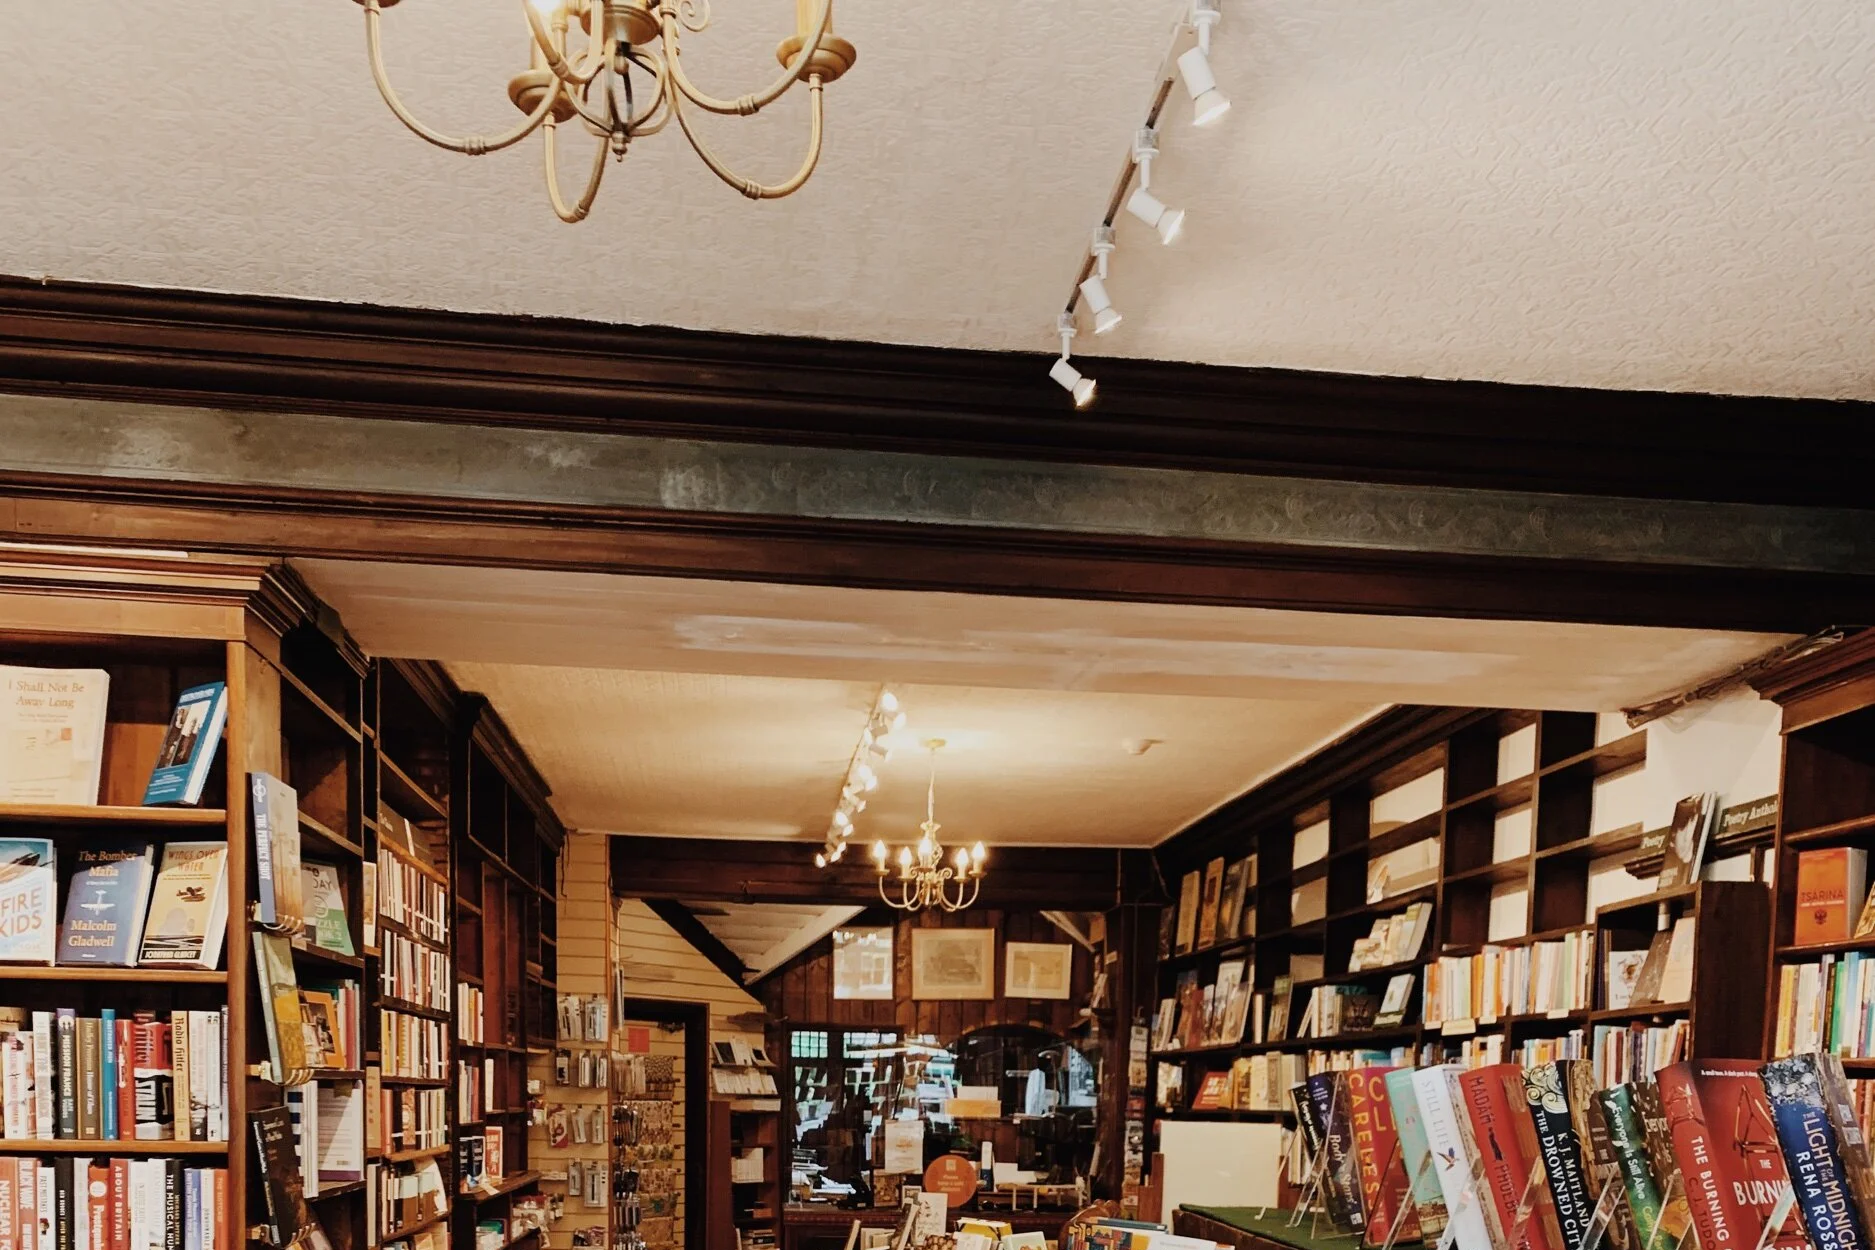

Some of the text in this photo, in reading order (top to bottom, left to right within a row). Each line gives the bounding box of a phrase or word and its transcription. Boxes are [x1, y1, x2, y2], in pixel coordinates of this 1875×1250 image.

[16, 681, 85, 693] Shall Not Be
[16, 696, 74, 709] Away Long
[79, 851, 136, 862] The Bomber
[88, 866, 119, 877] Mafia
[1802, 890, 1844, 901] TSARINA
[69, 936, 114, 947] Gladwell
[71, 920, 117, 931] Malcolm
[62, 1035, 72, 1096] MISSION FRANCE
[135, 1081, 156, 1120] STALIN
[1421, 1079, 1449, 1147] STILL LIFE
[1469, 1075, 1494, 1126] MADAM
[1329, 1134, 1347, 1164] Body
[1535, 1111, 1549, 1134] THE
[1542, 1135, 1573, 1217] DROWNED
[1611, 1104, 1646, 1200] Everyone Still Alive
[1760, 1160, 1772, 1169] THE
[1804, 1118, 1832, 1168] LIGHT
[19, 1160, 34, 1209] BLACK WAVE
[1564, 1158, 1589, 1228] MAITLAND
[1691, 1136, 1709, 1164] THE
[1700, 1170, 1730, 1242] BURNING
[1796, 1152, 1820, 1198] RENA
[0, 1180, 12, 1236] NUCLEAR
